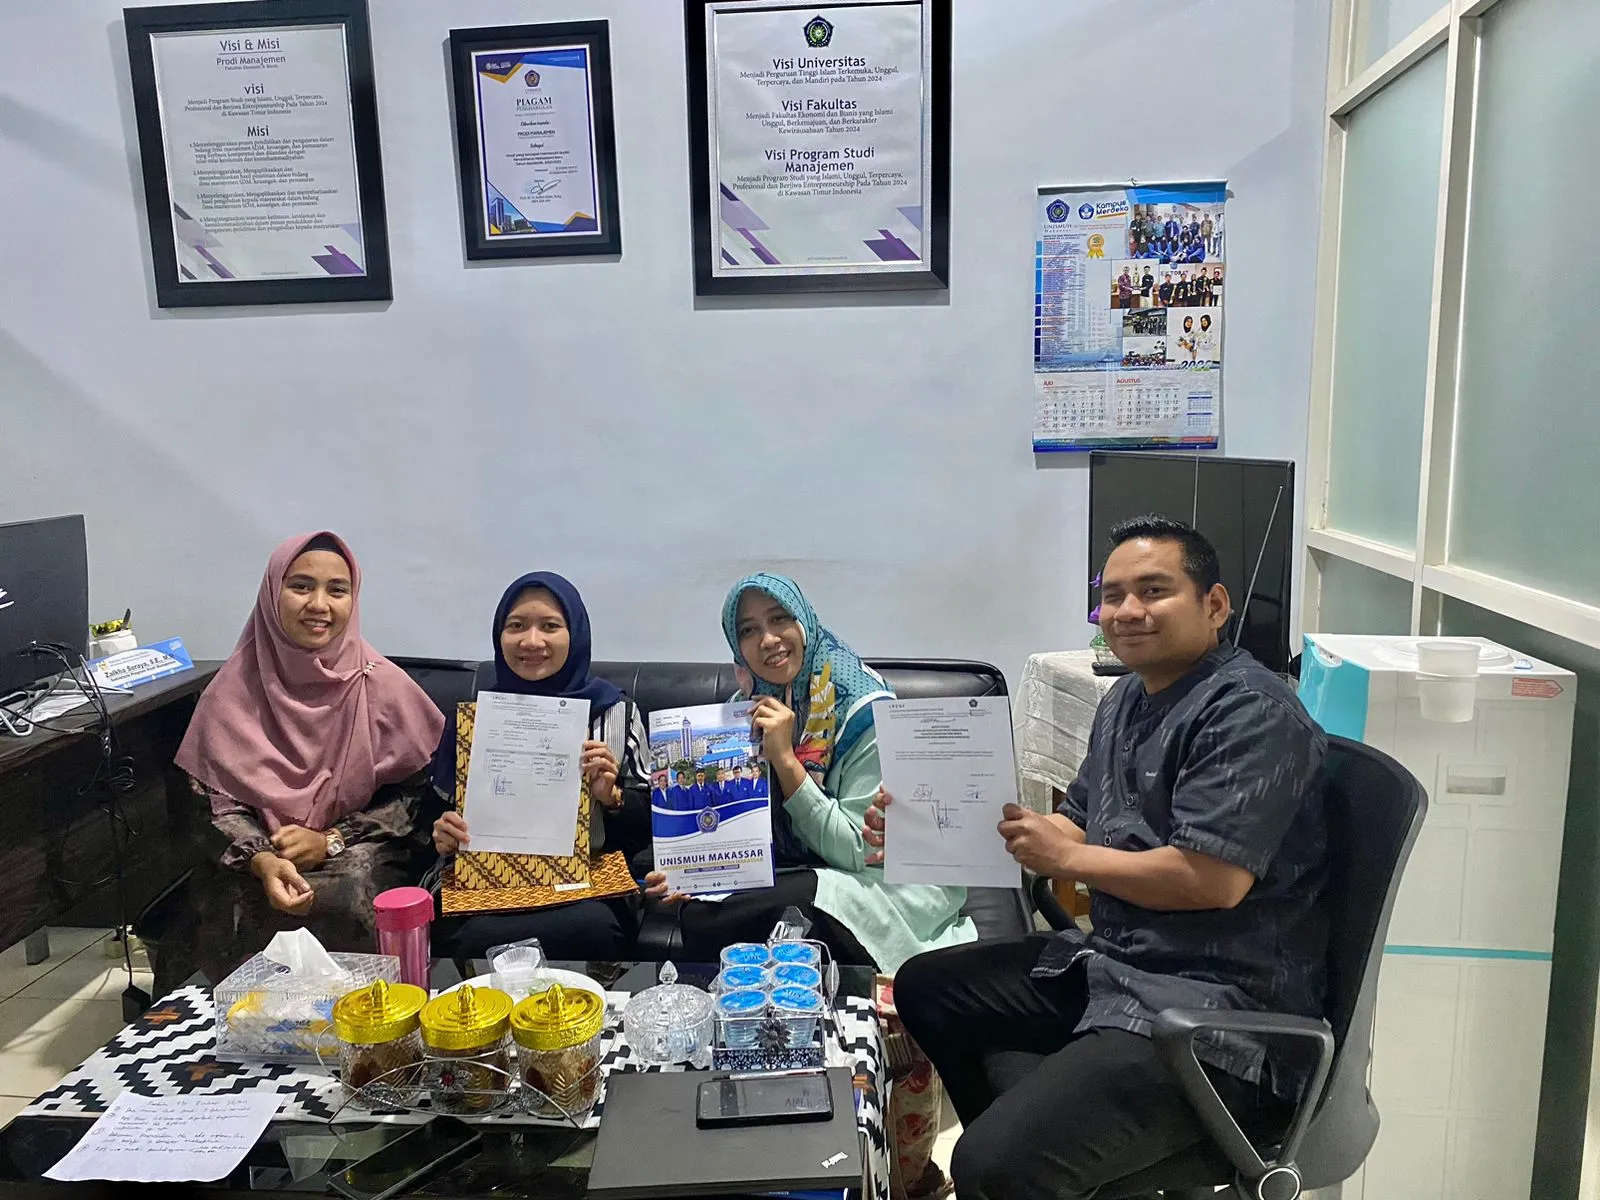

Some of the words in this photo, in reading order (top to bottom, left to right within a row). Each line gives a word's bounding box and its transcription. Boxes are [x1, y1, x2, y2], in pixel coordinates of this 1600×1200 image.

[220, 40, 240, 51] Visi
[245, 40, 252, 50] &
[258, 38, 280, 49] Misi
[217, 57, 237, 65] Prodi
[240, 55, 286, 65] Manajemen
[773, 58, 794, 70] Visi
[798, 56, 866, 68] Universitas
[740, 71, 765, 79] Menjadi
[766, 70, 797, 79] Perguruan
[874, 66, 899, 74] Unggul,
[244, 83, 264, 94] visi
[516, 97, 552, 106] PIAGAM
[782, 100, 802, 112] Visi
[807, 99, 857, 111] Fakultas
[761, 120, 785, 128] Unggul,
[786, 119, 828, 127] Berkemajuan,
[247, 125, 269, 137] Misi
[765, 150, 786, 161] Visi
[790, 149, 840, 162] Program
[844, 147, 875, 158] Studi
[785, 161, 854, 174] Manajemen
[737, 175, 761, 183] Menjadi
[763, 174, 788, 182] Program
[843, 172, 867, 180] Unggul,
[868, 171, 903, 179] Terpercaya,
[803, 180, 855, 189] Entrepreneurship
[1096, 200, 1127, 209] Kampus
[1096, 206, 1129, 215] Merdeka
[660, 854, 705, 866] UNISMUH
[708, 849, 764, 861] MAKASSAR
